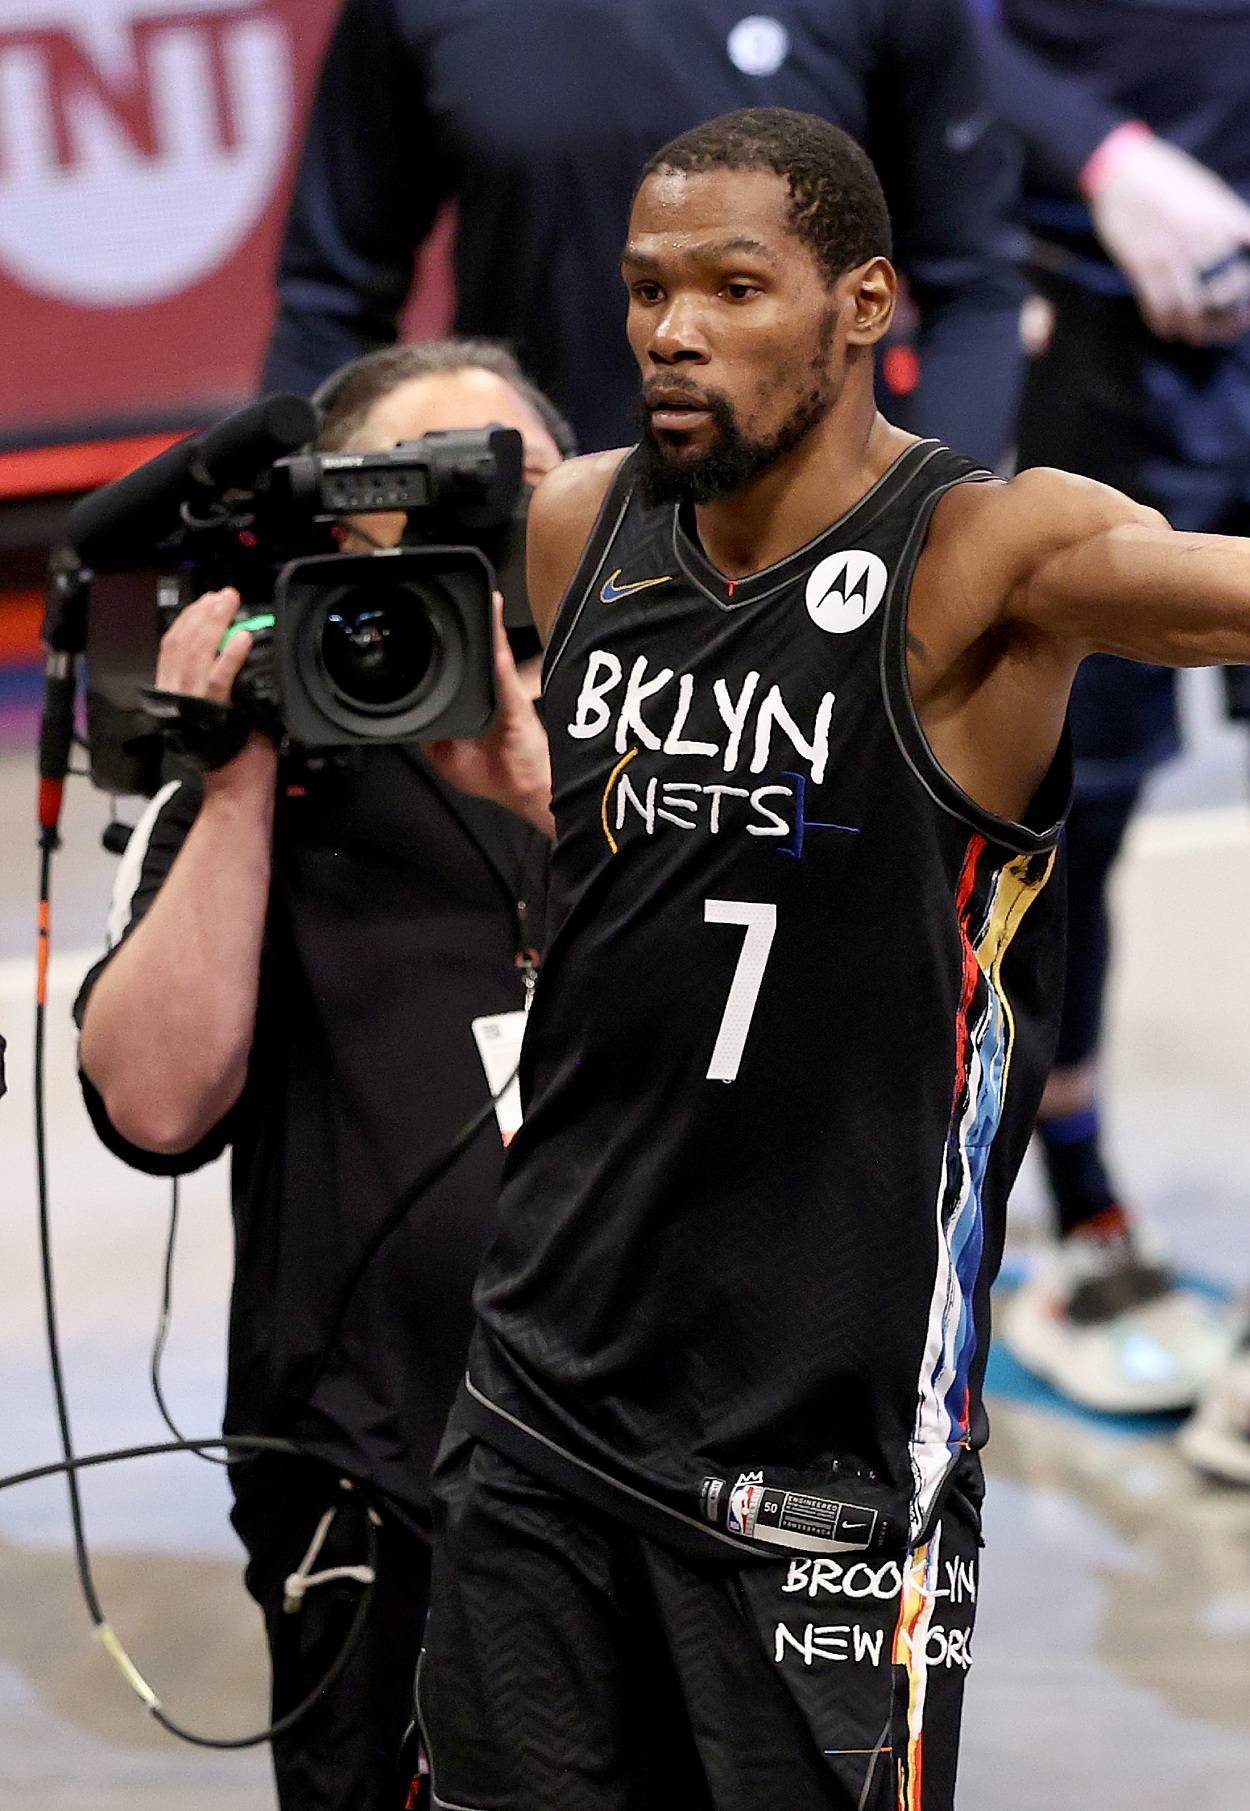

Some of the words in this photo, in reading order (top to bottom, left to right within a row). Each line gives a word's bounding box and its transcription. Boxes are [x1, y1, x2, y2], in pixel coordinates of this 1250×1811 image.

[0, 10, 268, 170] NT
[568, 650, 835, 784] BKLYN
[704, 899, 777, 1081] 7
[764, 1502, 777, 1513] 50
[781, 1555, 976, 1603] BROOKLYN
[775, 1622, 884, 1667] NEW
